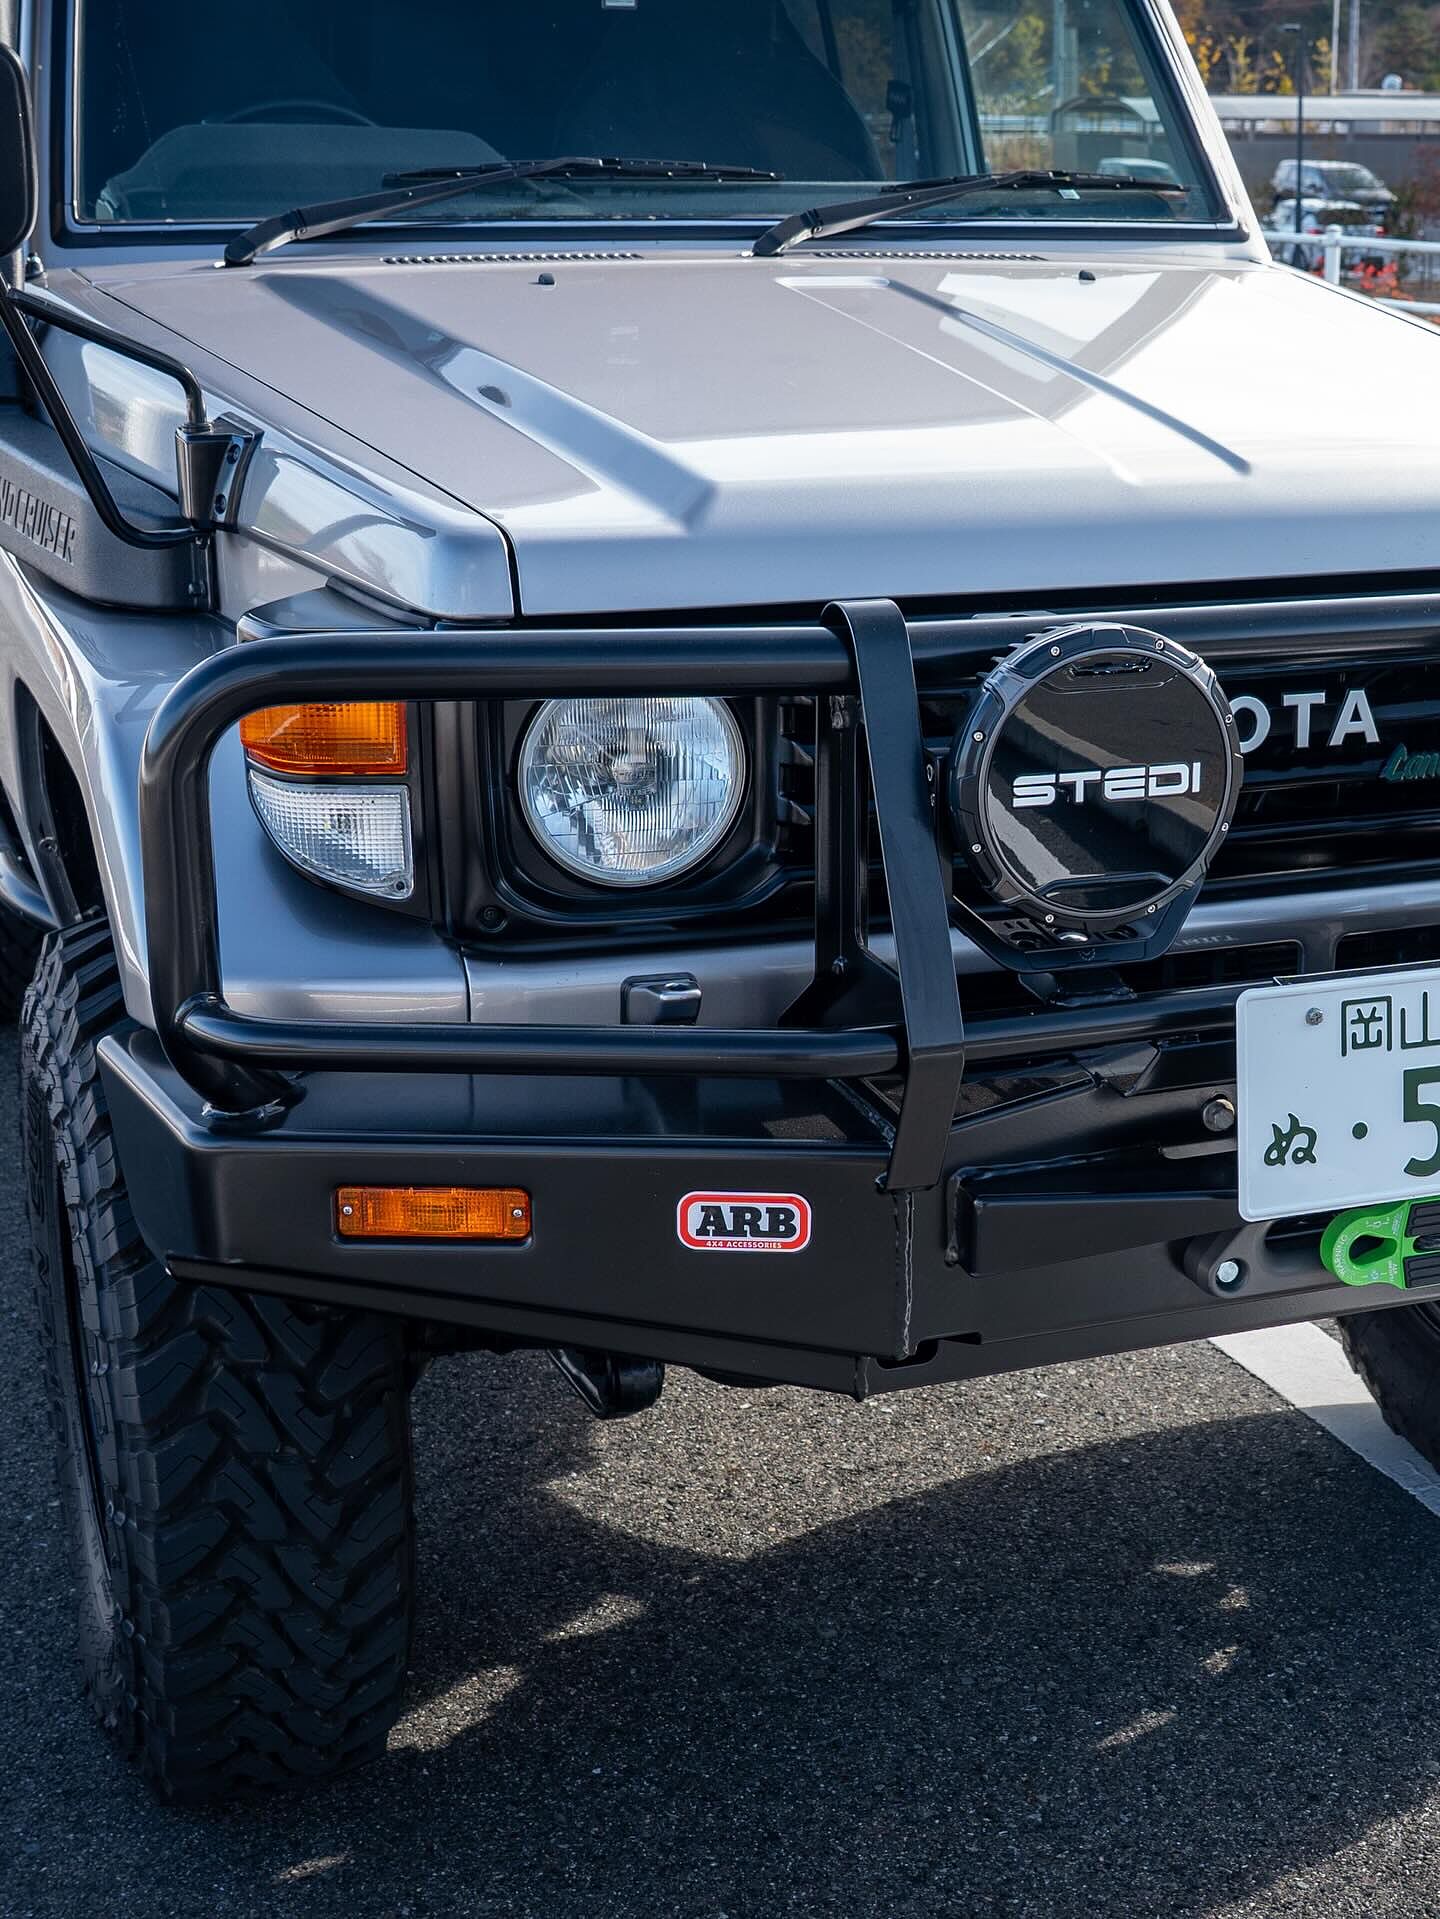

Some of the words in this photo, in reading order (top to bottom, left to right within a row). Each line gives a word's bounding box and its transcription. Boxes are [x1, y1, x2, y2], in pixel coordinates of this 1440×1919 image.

[1230, 687, 1382, 755] OTA
[1013, 762, 1201, 808] STEDI
[695, 1205, 798, 1239] ARB
[727, 1241, 782, 1249] ACCESSORIES
